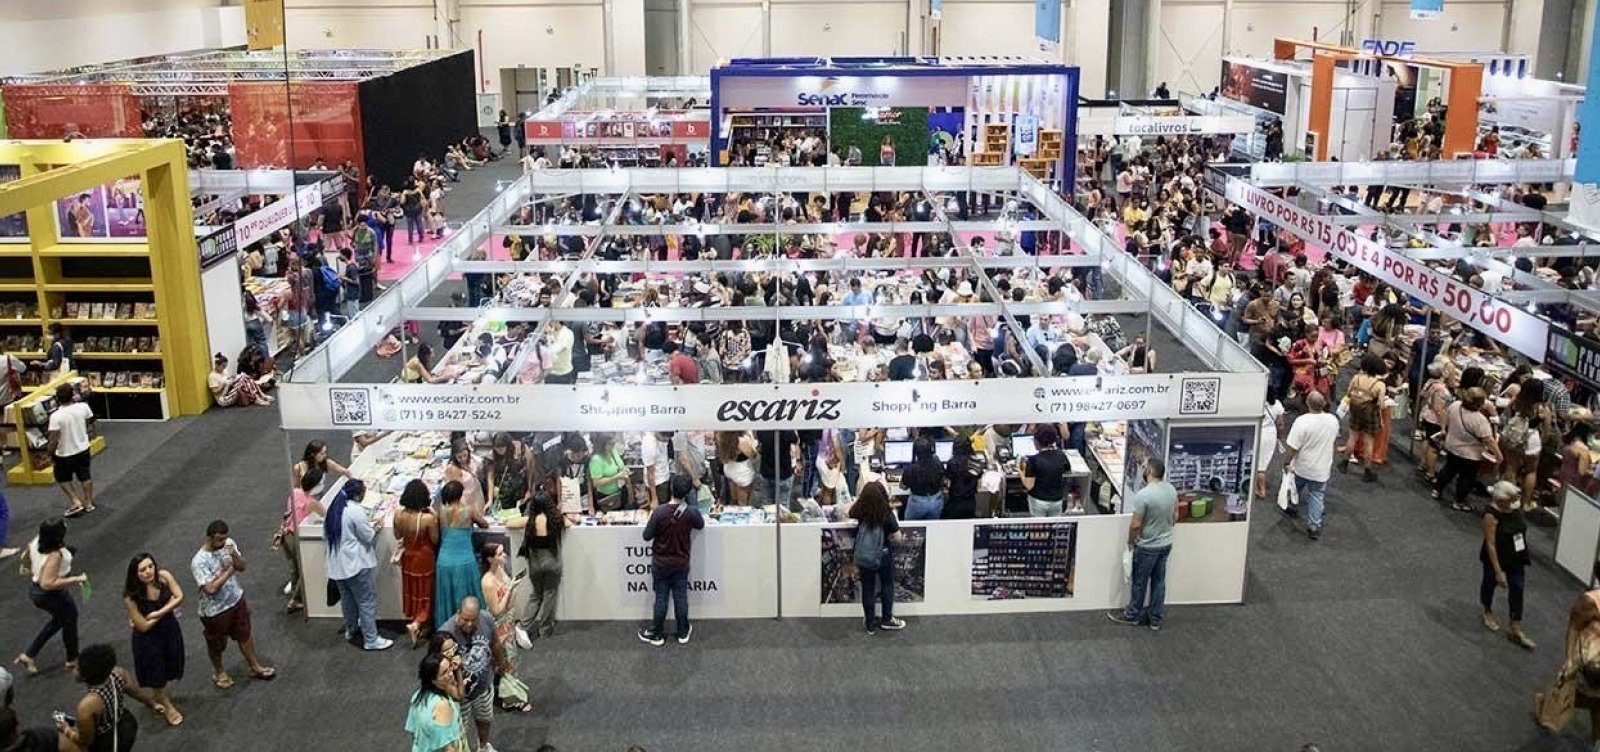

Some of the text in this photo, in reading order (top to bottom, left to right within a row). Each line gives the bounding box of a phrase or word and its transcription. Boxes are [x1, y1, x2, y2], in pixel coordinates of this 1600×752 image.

[797, 93, 848, 106] Senac
[1129, 120, 1188, 132] tocalivros
[1246, 188, 1274, 213] LIVRO
[1276, 205, 1298, 227] POR
[1301, 216, 1314, 235] R$
[1361, 245, 1368, 261] E
[1371, 253, 1380, 266] 4
[1383, 255, 1414, 285] POR
[1418, 272, 1439, 298] R$
[1442, 282, 1512, 333] 50,00
[400, 393, 520, 405] www.escariz.com.br
[717, 388, 842, 422] escariz
[650, 404, 687, 415] Barra
[872, 399, 977, 413] Shopng Barra
[1050, 402, 1073, 413] (71)
[437, 409, 502, 420] 8427-5242
[625, 546, 653, 557] TUD
[627, 581, 648, 592] NA
